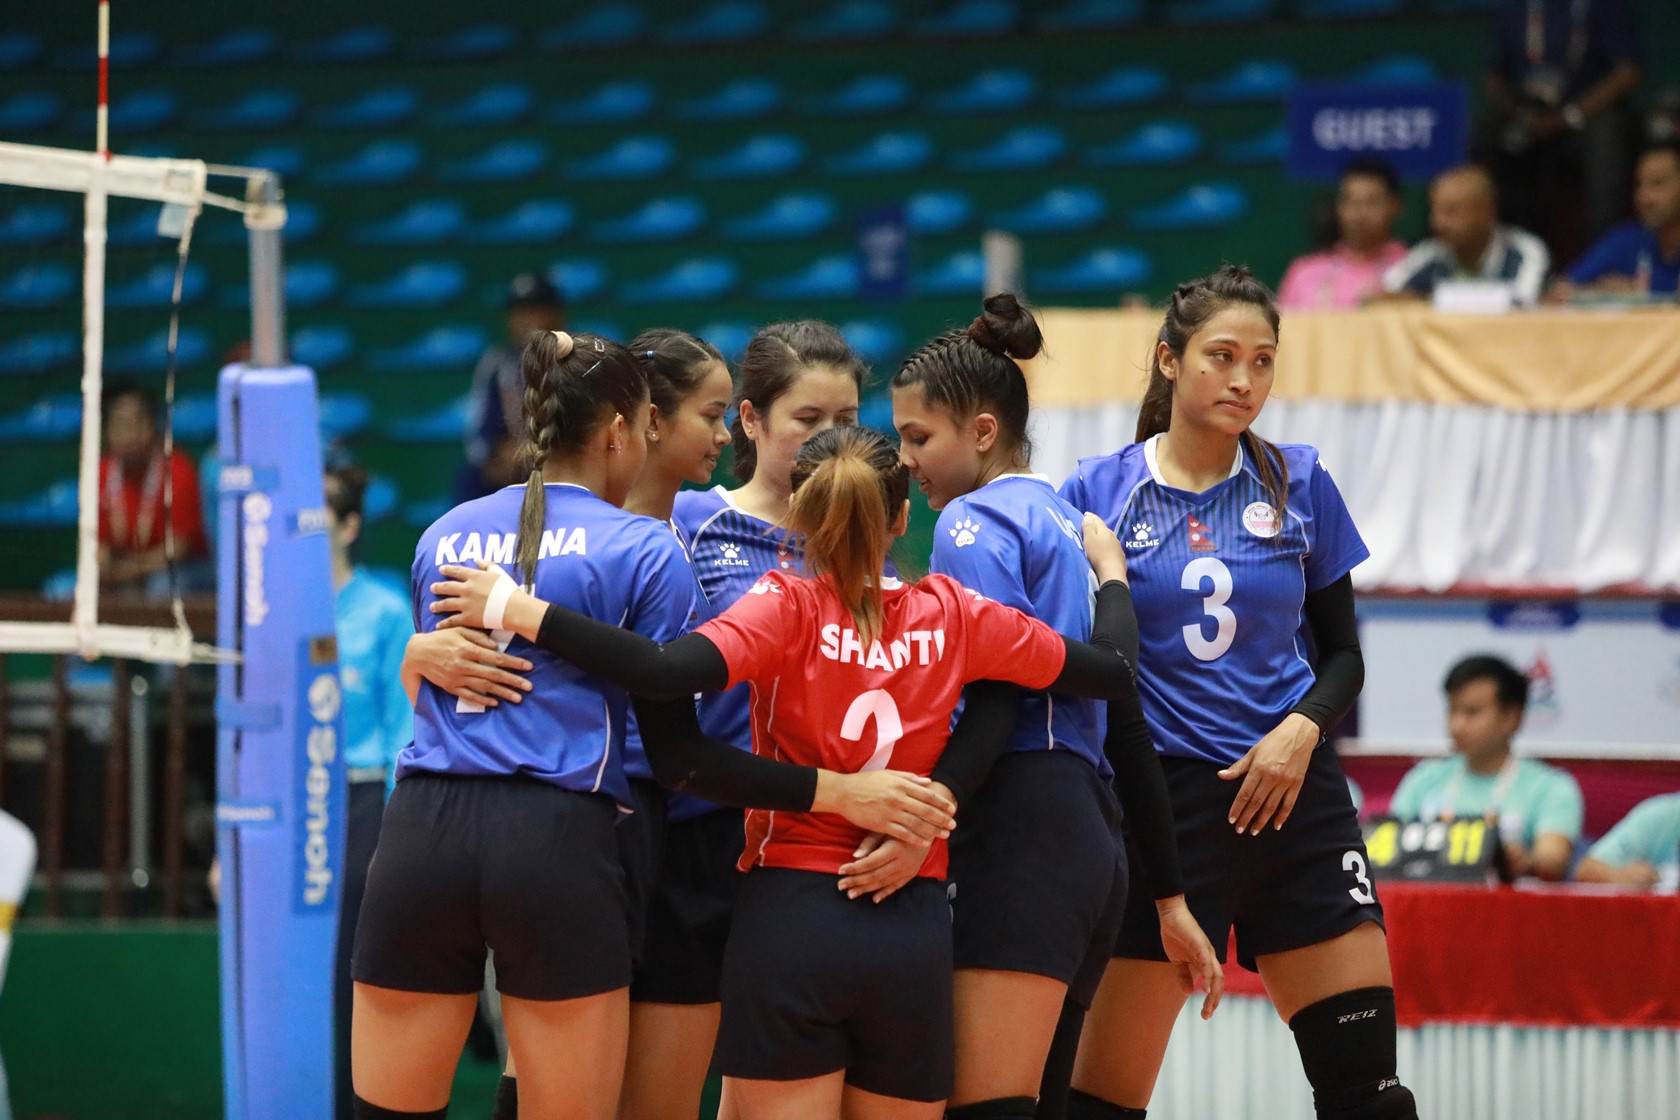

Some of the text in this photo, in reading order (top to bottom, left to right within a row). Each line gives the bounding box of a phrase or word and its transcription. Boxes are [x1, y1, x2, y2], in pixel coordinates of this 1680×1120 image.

[1313, 107, 1437, 150] GUEST
[435, 527, 586, 566] KAMNA
[714, 559, 750, 567] KELME
[1125, 538, 1160, 549] KELME
[1181, 557, 1237, 661] 3
[819, 623, 945, 672] SHANTI
[840, 688, 904, 773] 2
[1342, 850, 1376, 905] 3
